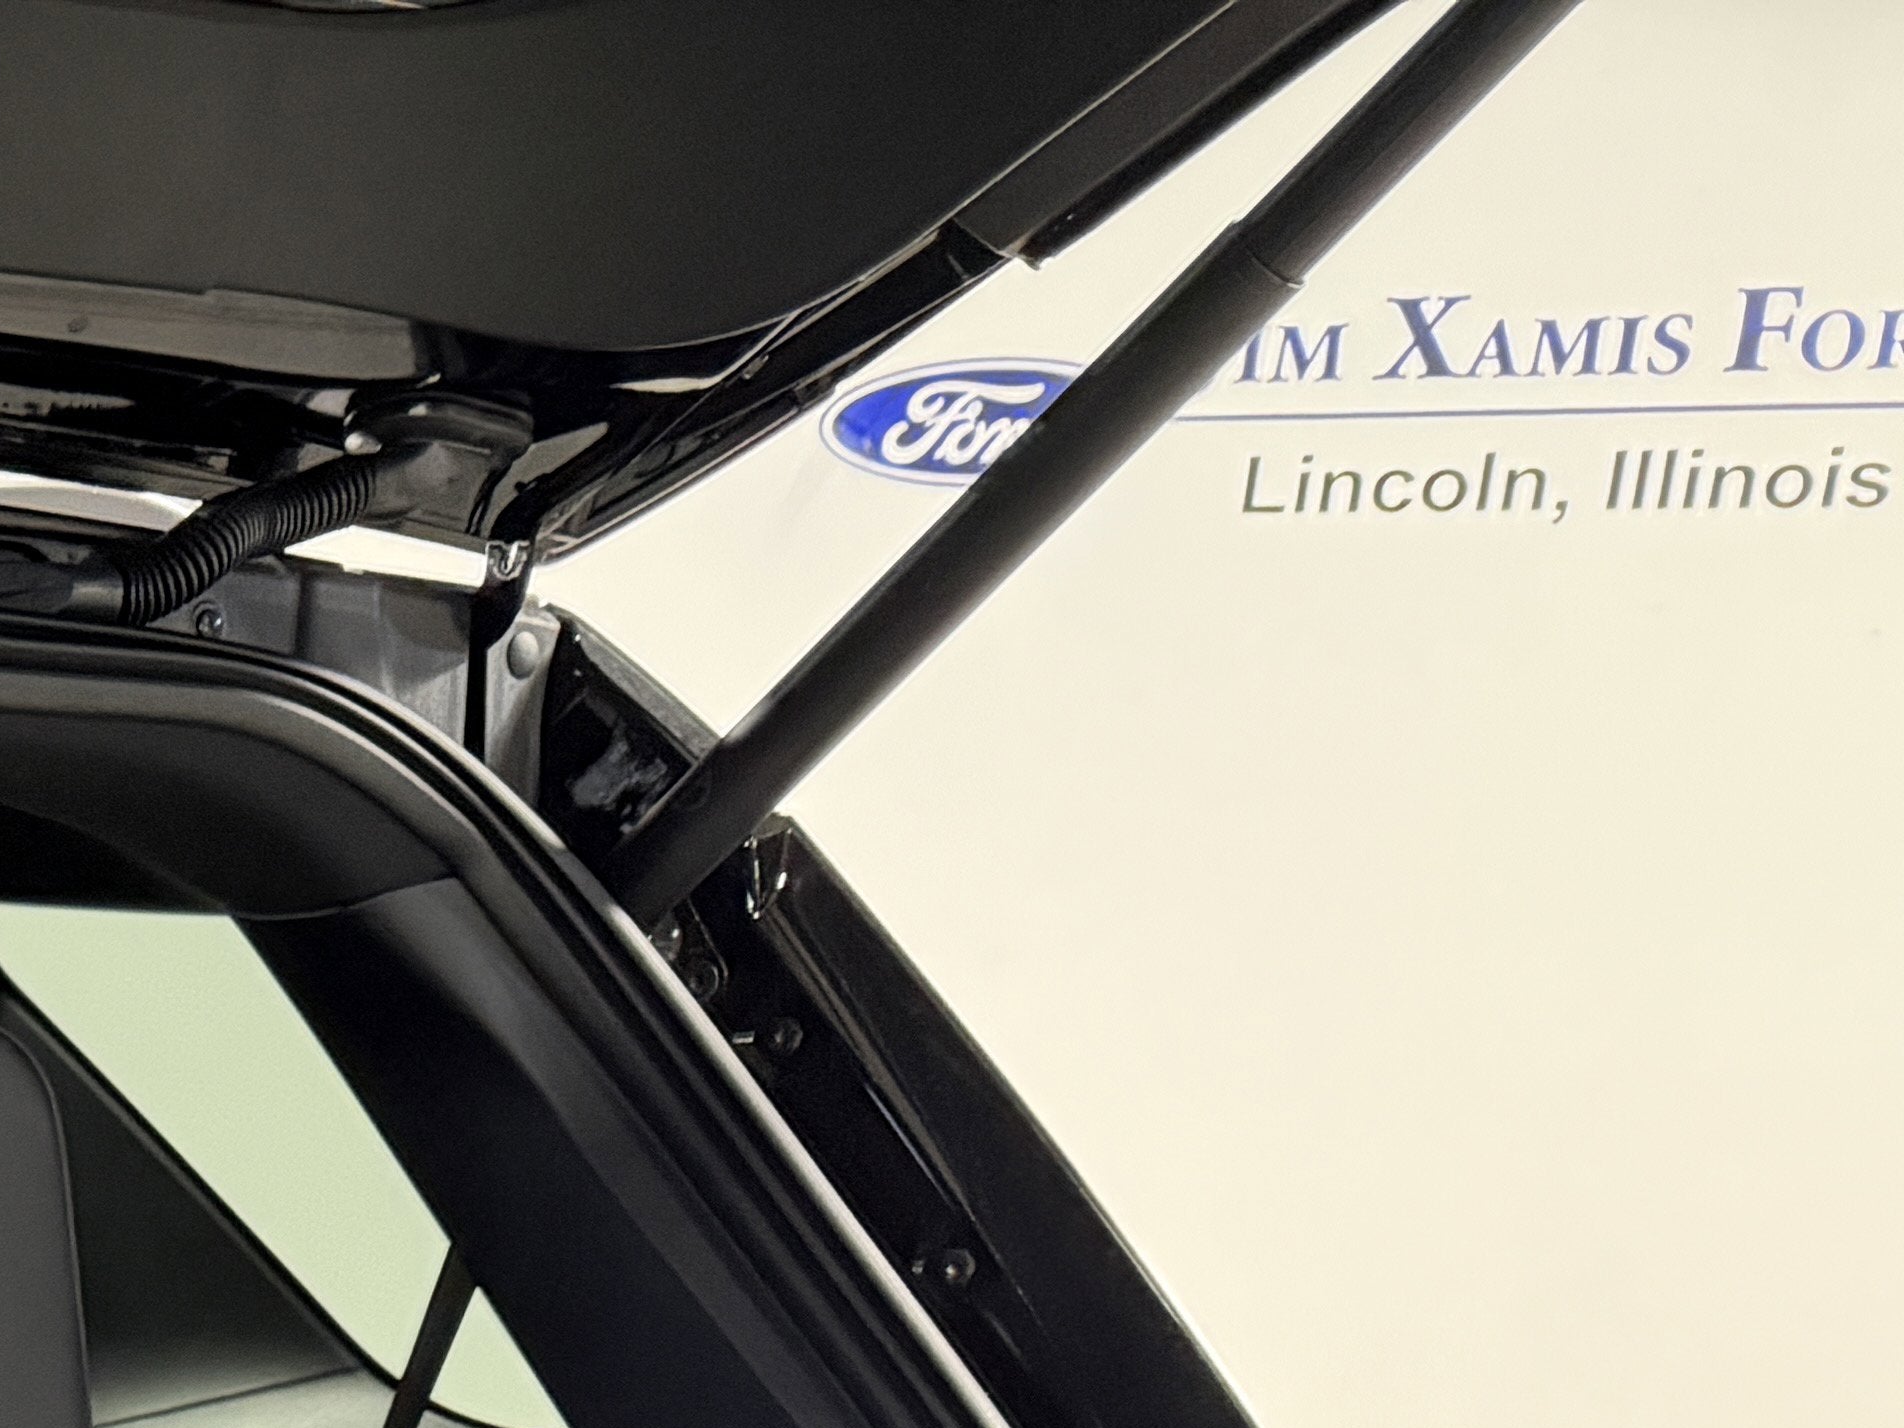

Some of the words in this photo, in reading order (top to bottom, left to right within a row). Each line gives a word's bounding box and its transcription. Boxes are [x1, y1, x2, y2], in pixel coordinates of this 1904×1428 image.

[1233, 321, 1349, 384] IM
[1372, 294, 1693, 381] XAMIS
[1723, 285, 1904, 372] FOR
[881, 379, 1046, 465] For
[1242, 451, 1568, 524] Lincoln,
[1606, 446, 1892, 510] Illinois
